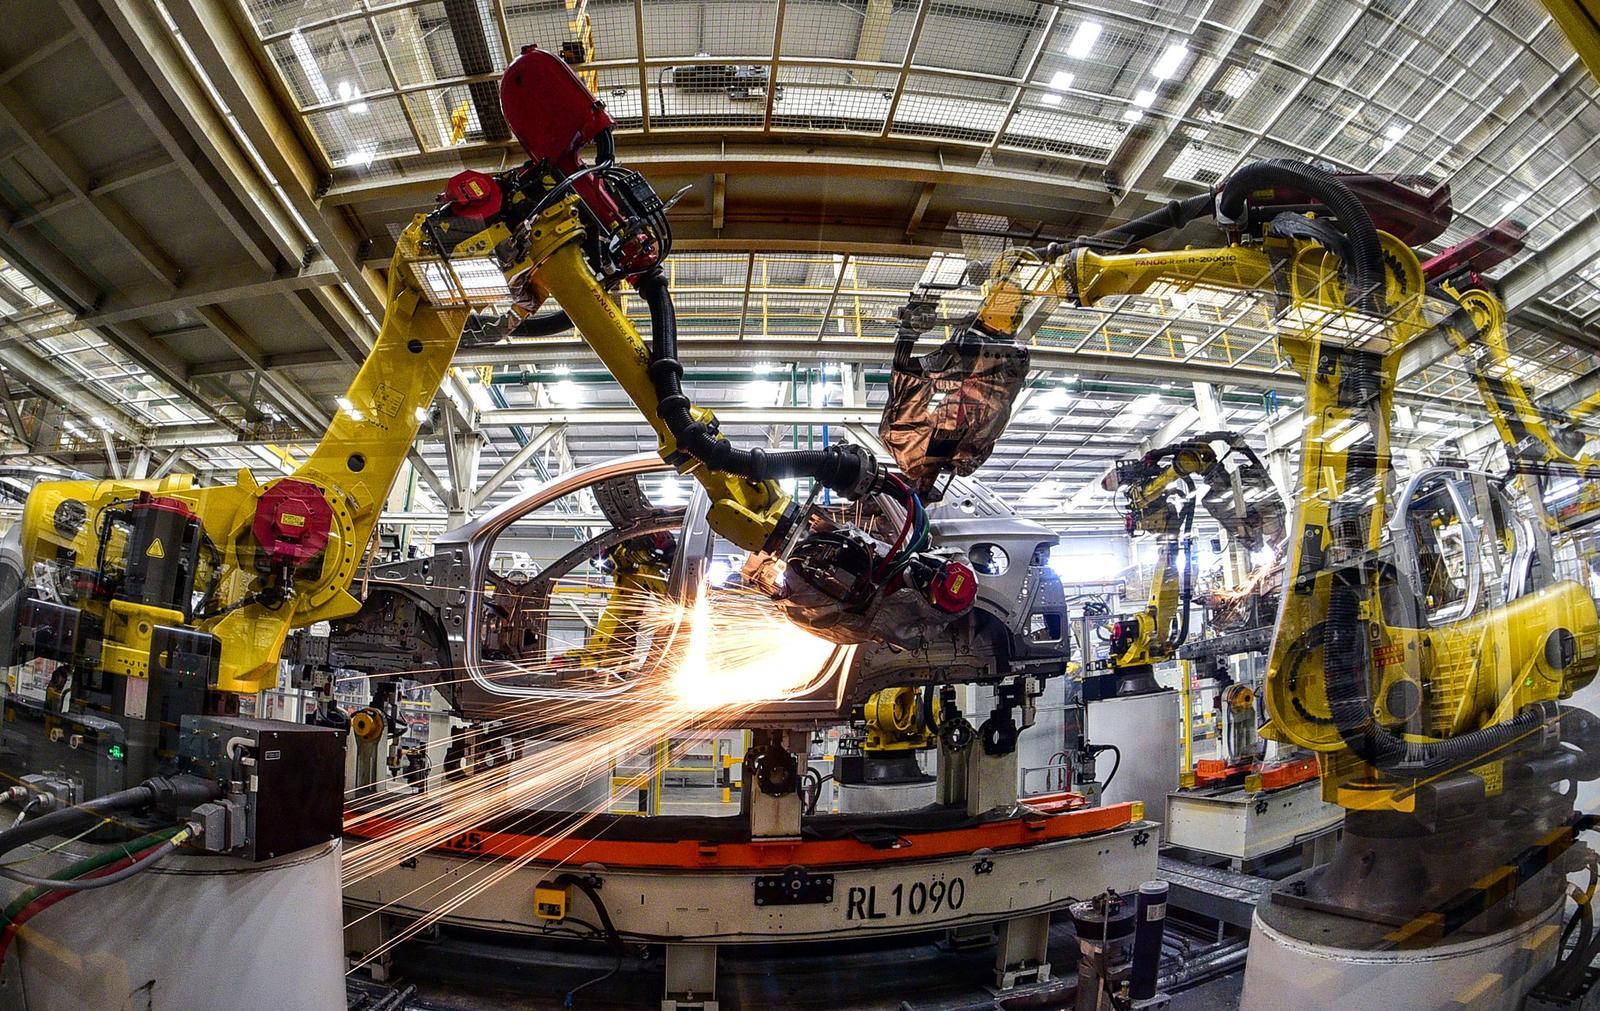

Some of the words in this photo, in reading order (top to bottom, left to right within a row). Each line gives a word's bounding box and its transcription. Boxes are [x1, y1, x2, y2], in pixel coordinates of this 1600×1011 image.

[1135, 258, 1167, 267] FANUC
[591, 287, 616, 319] FANUC
[847, 877, 965, 920] RL1090
